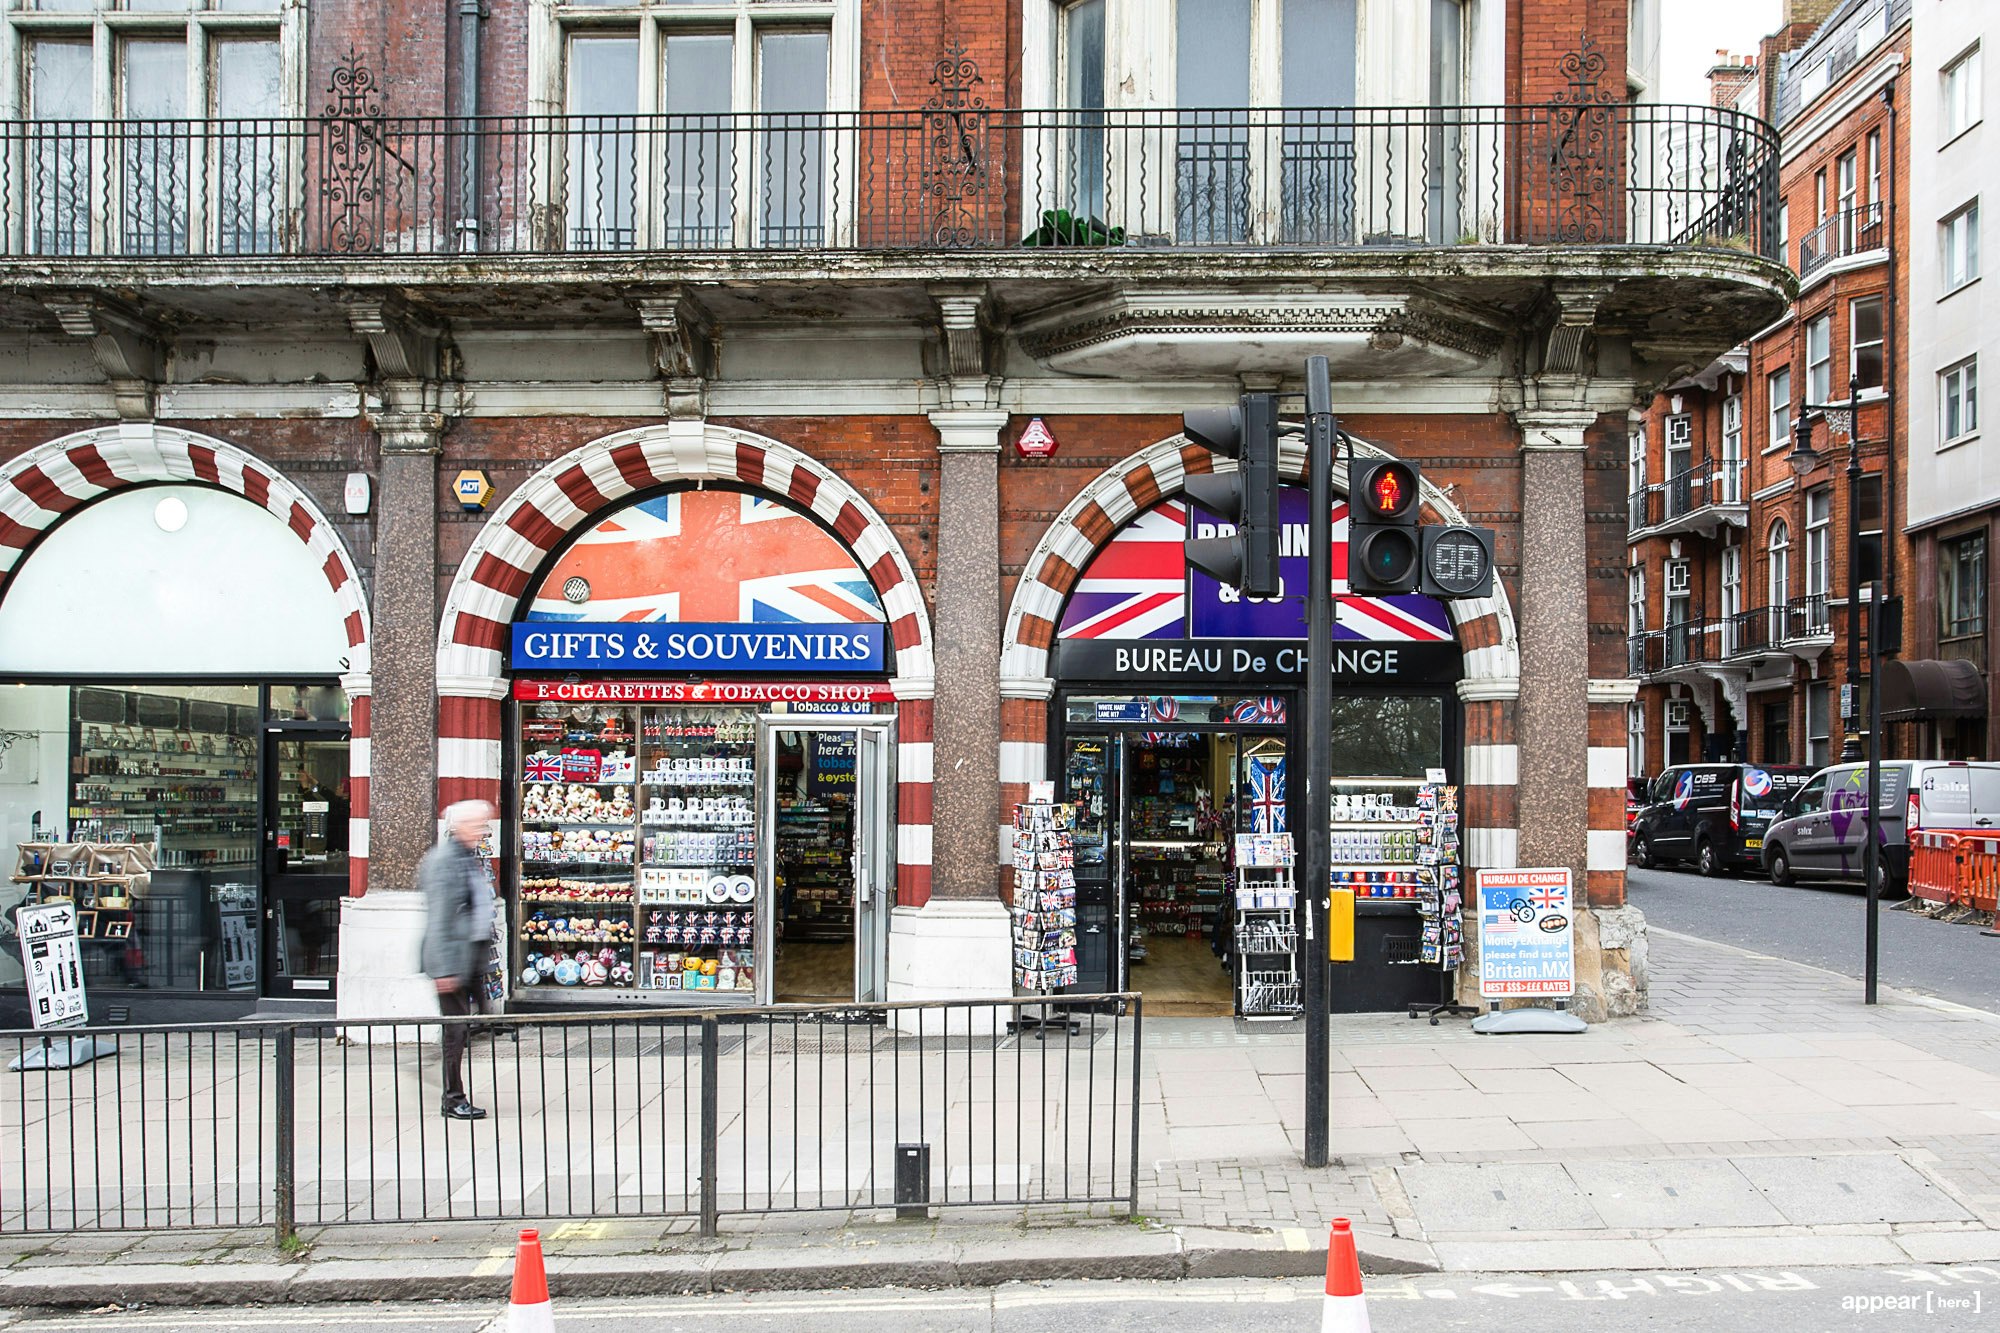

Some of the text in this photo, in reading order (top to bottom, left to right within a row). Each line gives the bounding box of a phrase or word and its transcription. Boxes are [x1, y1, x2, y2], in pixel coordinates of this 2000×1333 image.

[461, 481, 478, 492] ADT
[524, 633, 871, 660] GIFTS & SOUVENIRS
[1115, 648, 1399, 674] BUREAU De CHNGE
[537, 683, 875, 701] E-CIGARETTES & TOBACCO SHOP
[791, 701, 839, 713] Tobacco
[840, 702, 851, 713] &
[818, 732, 841, 743] Pleas
[818, 743, 844, 756] here
[818, 756, 857, 769] tobac
[1694, 773, 1717, 784] DBS
[1772, 775, 1810, 784] DBS
[1934, 781, 1969, 792] salix
[1797, 826, 1812, 836] salix
[1483, 873, 1565, 885] BUREAU DE CHANGE
[1540, 918, 1567, 928] open
[1485, 935, 1517, 949] Money
[1485, 950, 1569, 961] please find us on
[1485, 960, 1570, 980] Britain.MX
[1486, 983, 1505, 992] BEST
[1543, 981, 1569, 992] RATES
